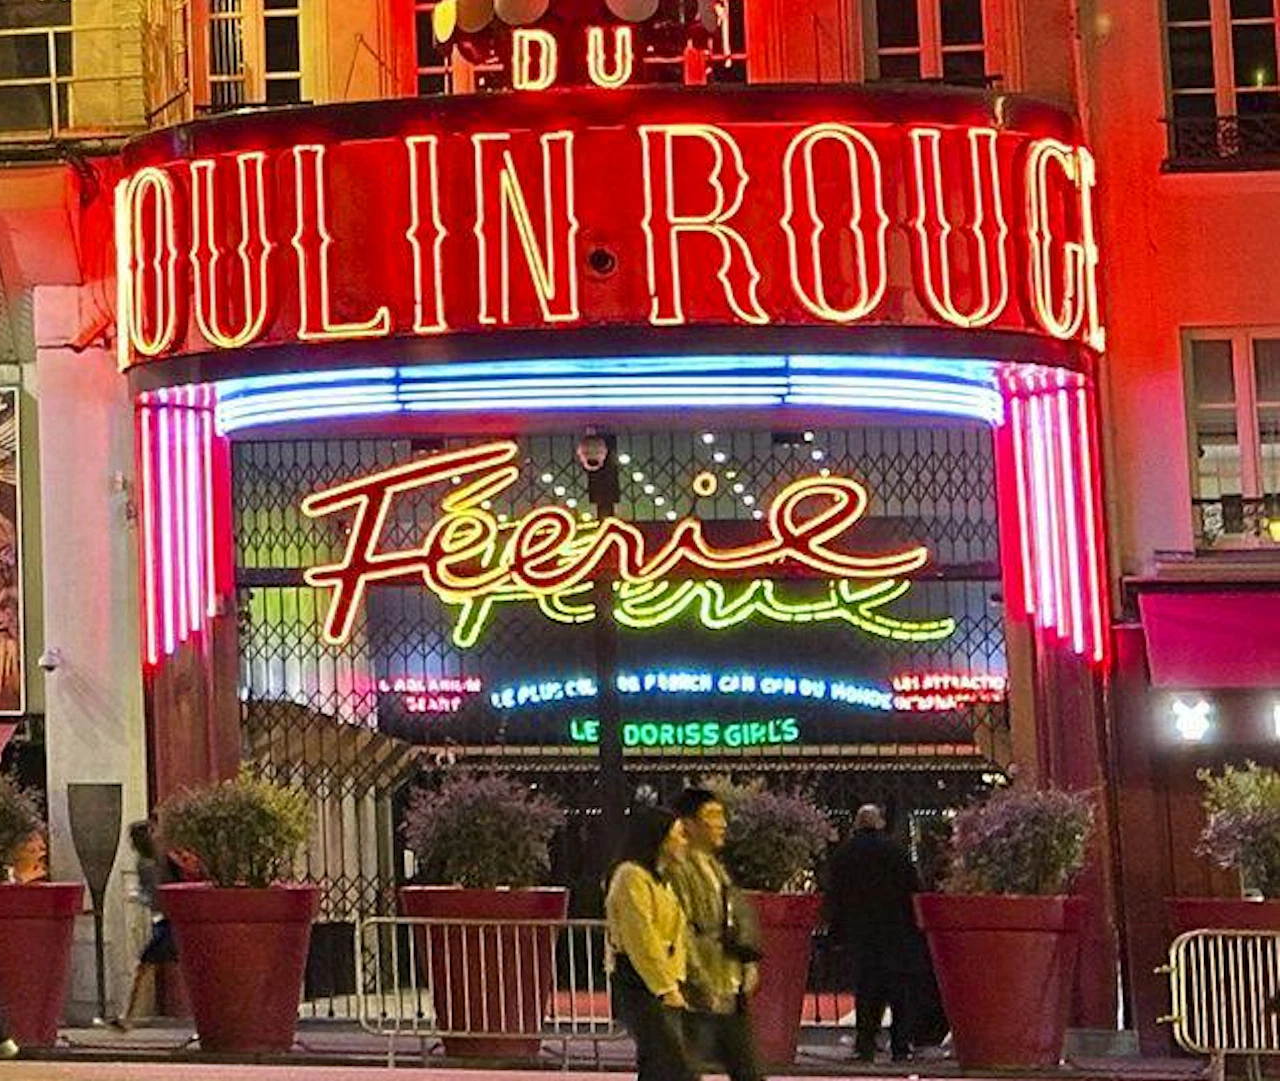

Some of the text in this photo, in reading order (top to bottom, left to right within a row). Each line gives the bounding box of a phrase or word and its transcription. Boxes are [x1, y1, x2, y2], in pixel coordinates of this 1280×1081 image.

[512, 26, 633, 90] DU
[115, 123, 1105, 372] OULIN ROUG
[300, 440, 930, 645] Féerie
[491, 692, 515, 709] LE
[517, 680, 564, 704] PLUS
[717, 675, 756, 693] CAN
[759, 677, 797, 695] CAN
[799, 678, 826, 698] DU
[830, 682, 893, 711] MONDE
[623, 723, 720, 746] DORISS
